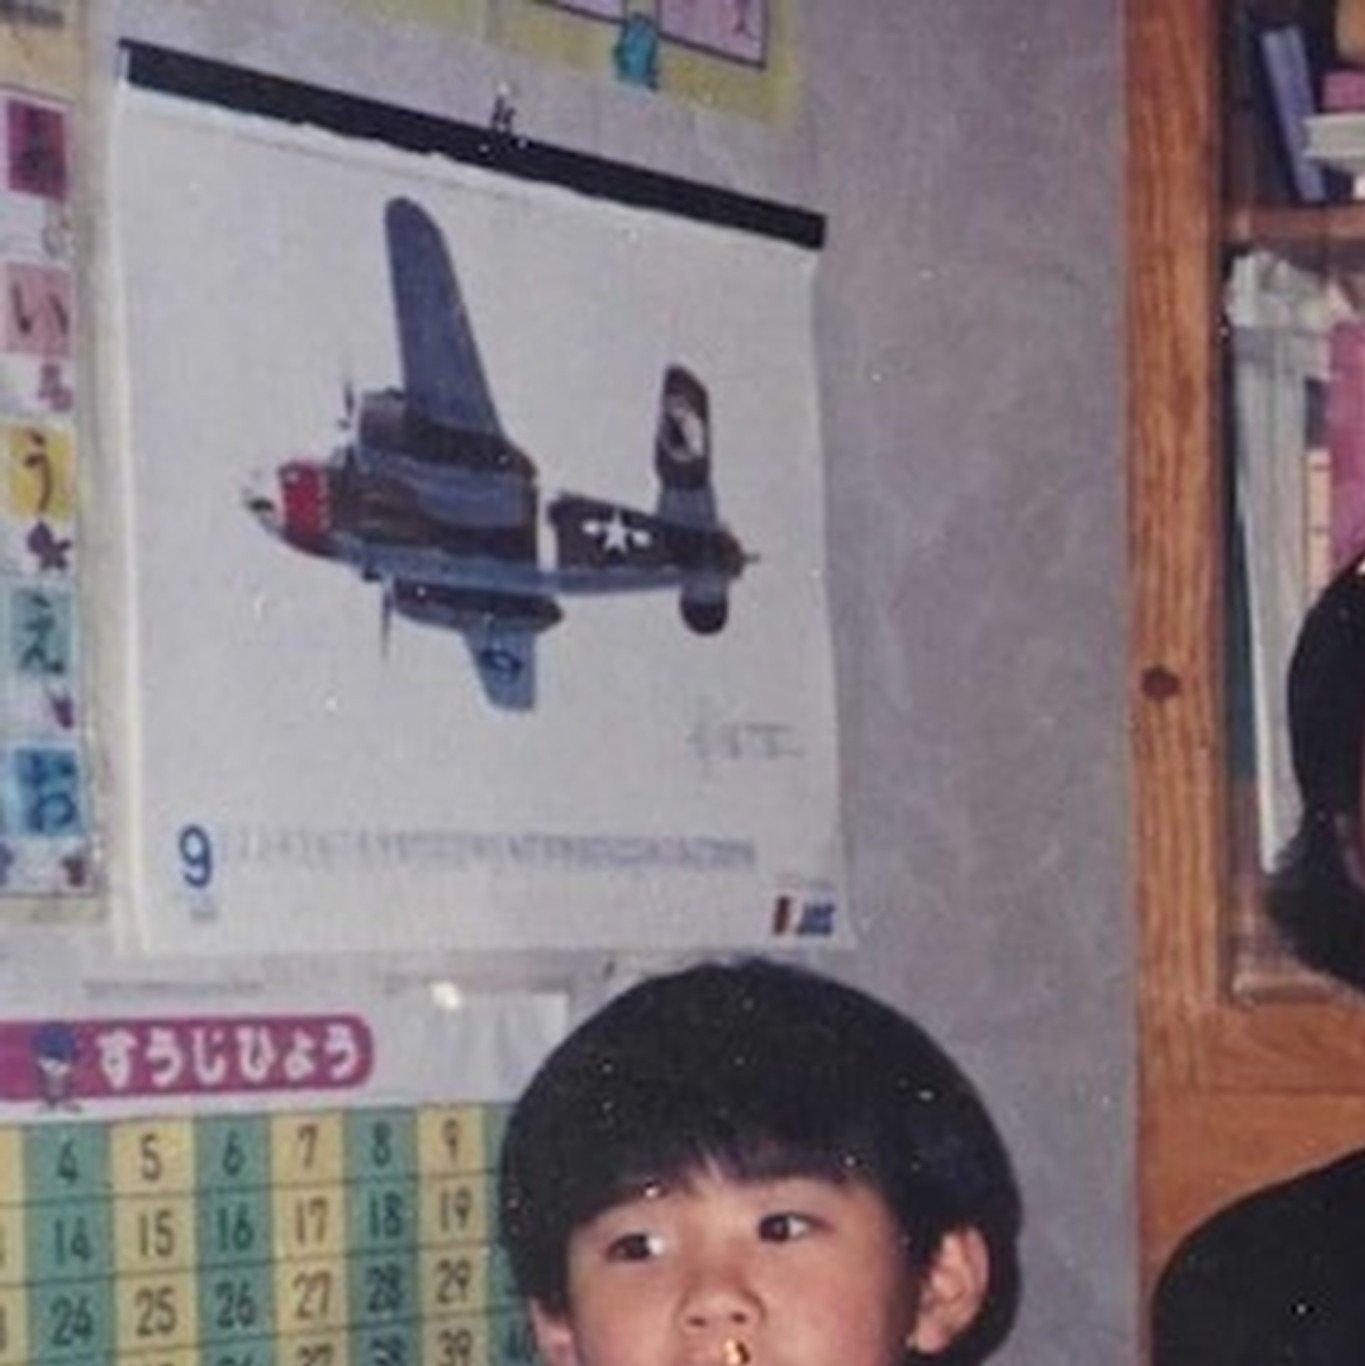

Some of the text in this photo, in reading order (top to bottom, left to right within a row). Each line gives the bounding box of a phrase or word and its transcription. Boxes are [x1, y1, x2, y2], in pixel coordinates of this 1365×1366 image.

[11, 279, 70, 335] い
[24, 429, 54, 513] う
[18, 588, 66, 676] え
[178, 824, 213, 888] 9
[95, 1024, 357, 1090] すうじひょう
[57, 1117, 460, 1184] 4 5 6 7 8 9
[54, 1216, 91, 1265] 14
[138, 1209, 175, 1257] 15
[217, 1204, 255, 1252] 16
[295, 1196, 329, 1244] 17
[369, 1191, 403, 1239] 18
[440, 1186, 473, 1232] 19
[135, 1285, 177, 1338] 25
[216, 1281, 256, 1328] 26
[293, 1271, 331, 1320] 27
[436, 1259, 473, 1304] 29
